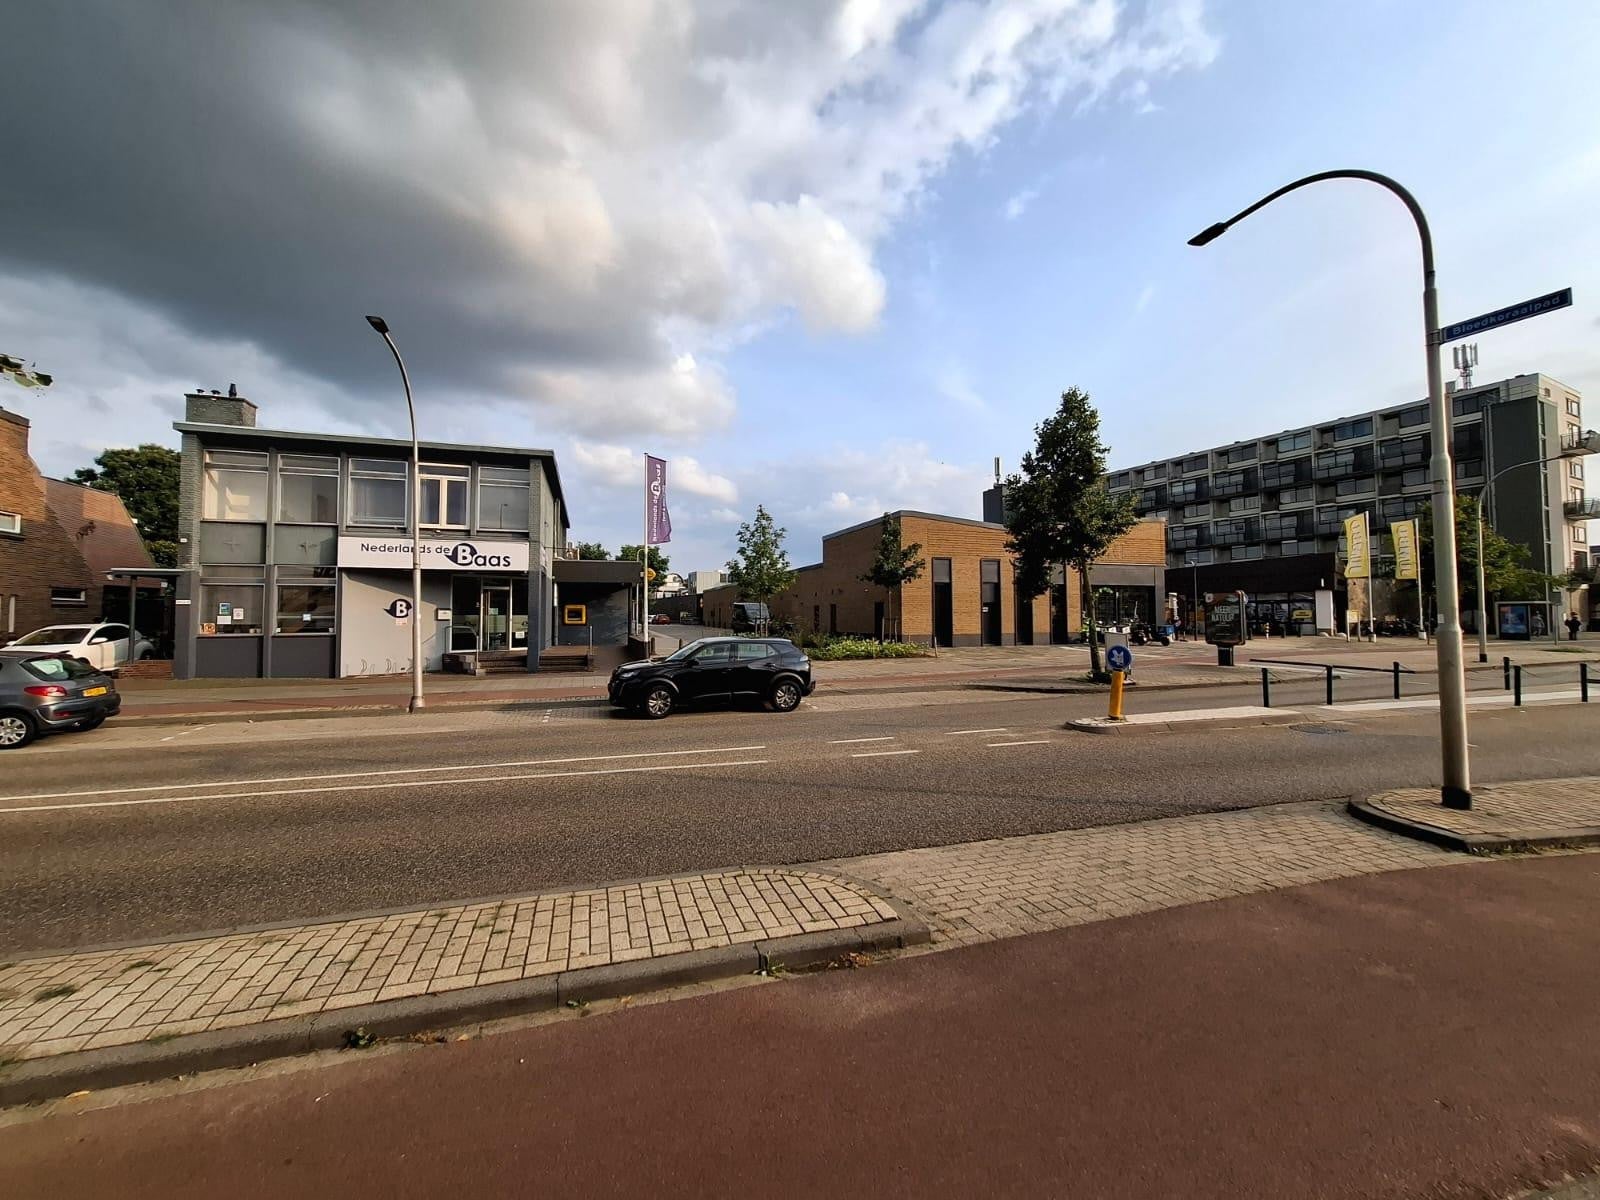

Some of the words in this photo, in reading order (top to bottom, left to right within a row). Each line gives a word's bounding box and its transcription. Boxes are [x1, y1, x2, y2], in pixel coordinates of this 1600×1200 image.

[1452, 295, 1561, 335] Bloedkoraalpad
[361, 543, 432, 554] Nederlads
[435, 543, 450, 554] de
[456, 544, 511, 567] Baas
[395, 600, 408, 617] B
